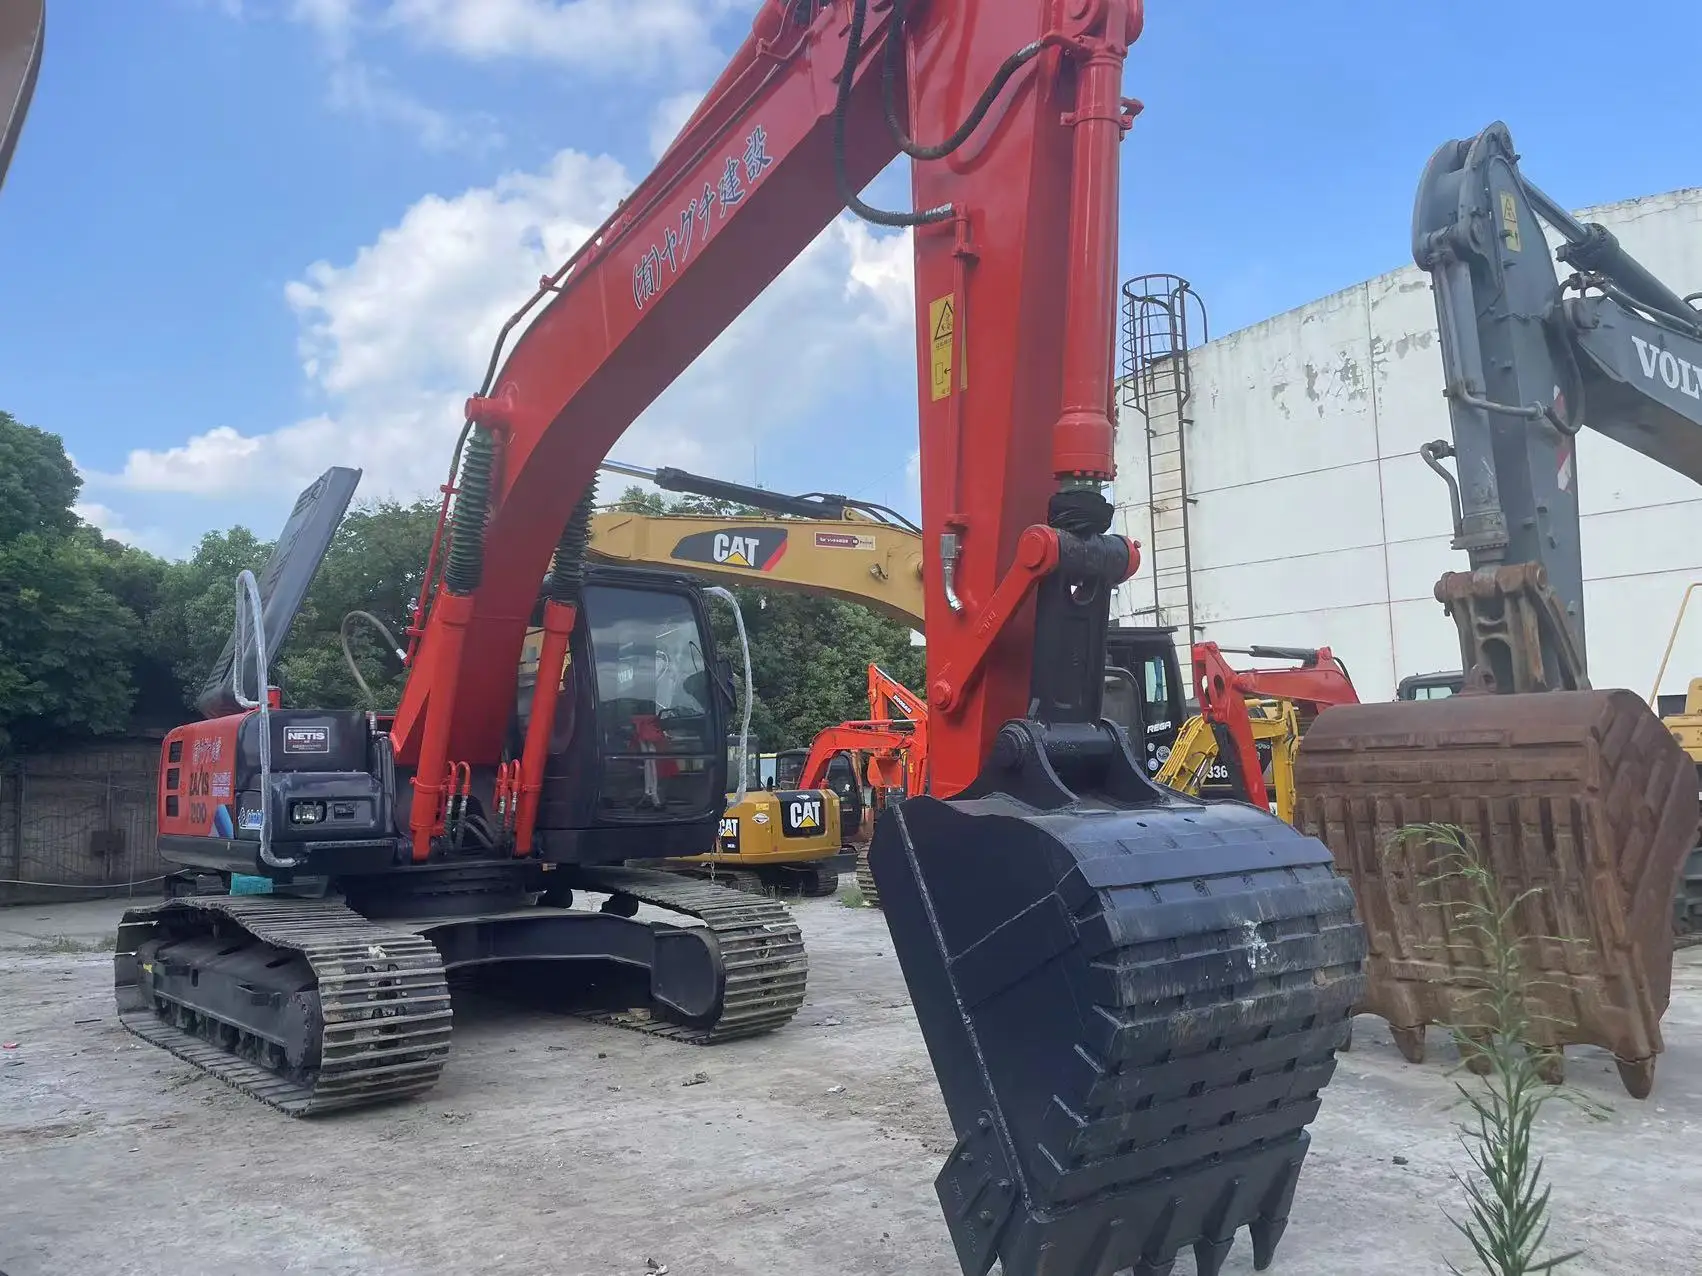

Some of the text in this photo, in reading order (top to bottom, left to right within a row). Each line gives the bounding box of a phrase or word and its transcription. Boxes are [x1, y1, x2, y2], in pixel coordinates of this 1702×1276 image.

[712, 533, 760, 567] CAT
[288, 732, 325, 740] NETIS
[1147, 720, 1171, 734] REGA
[790, 801, 820, 829] CAT
[719, 818, 738, 837] CAT
